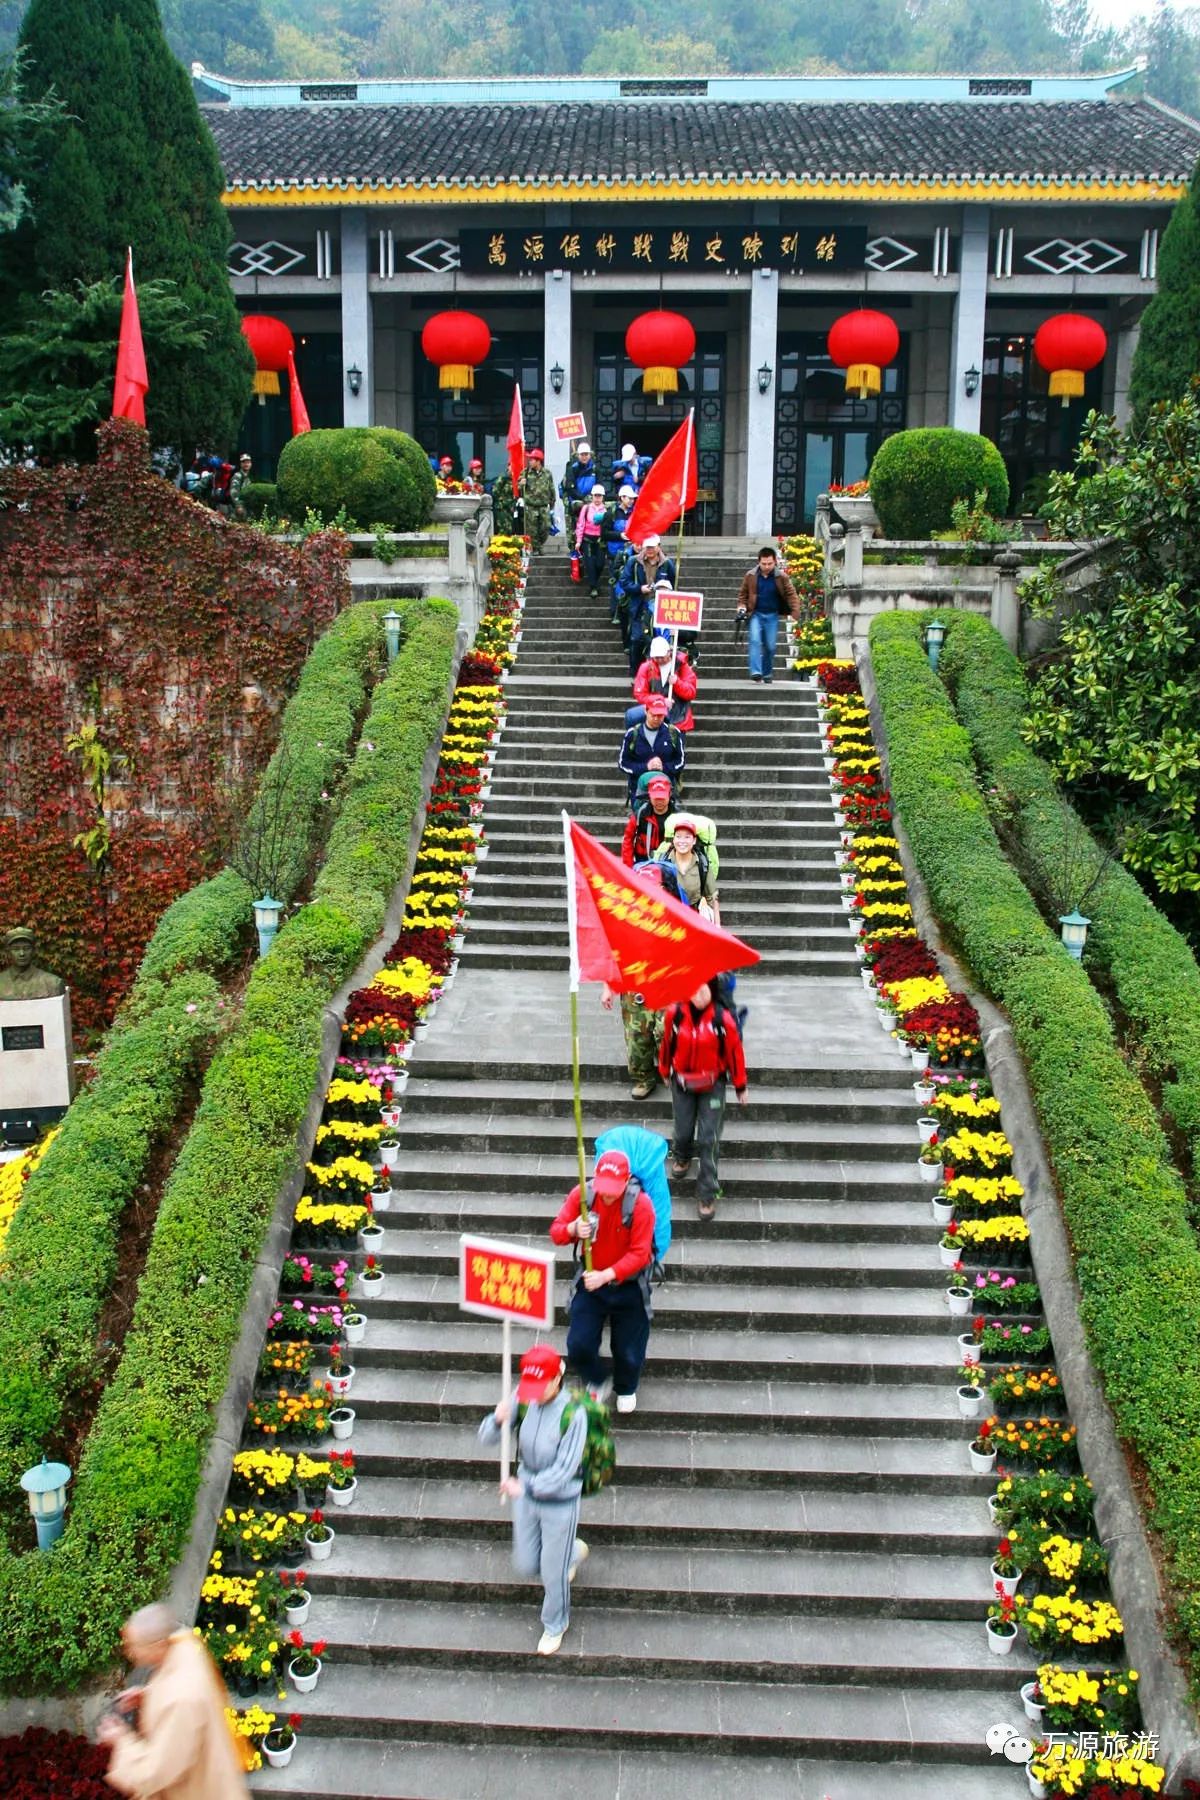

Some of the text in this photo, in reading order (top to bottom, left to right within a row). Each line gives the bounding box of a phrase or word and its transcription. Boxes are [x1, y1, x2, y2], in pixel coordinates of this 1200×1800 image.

[664, 610, 691, 623] 代表队
[480, 1279, 533, 1312] 代表队
